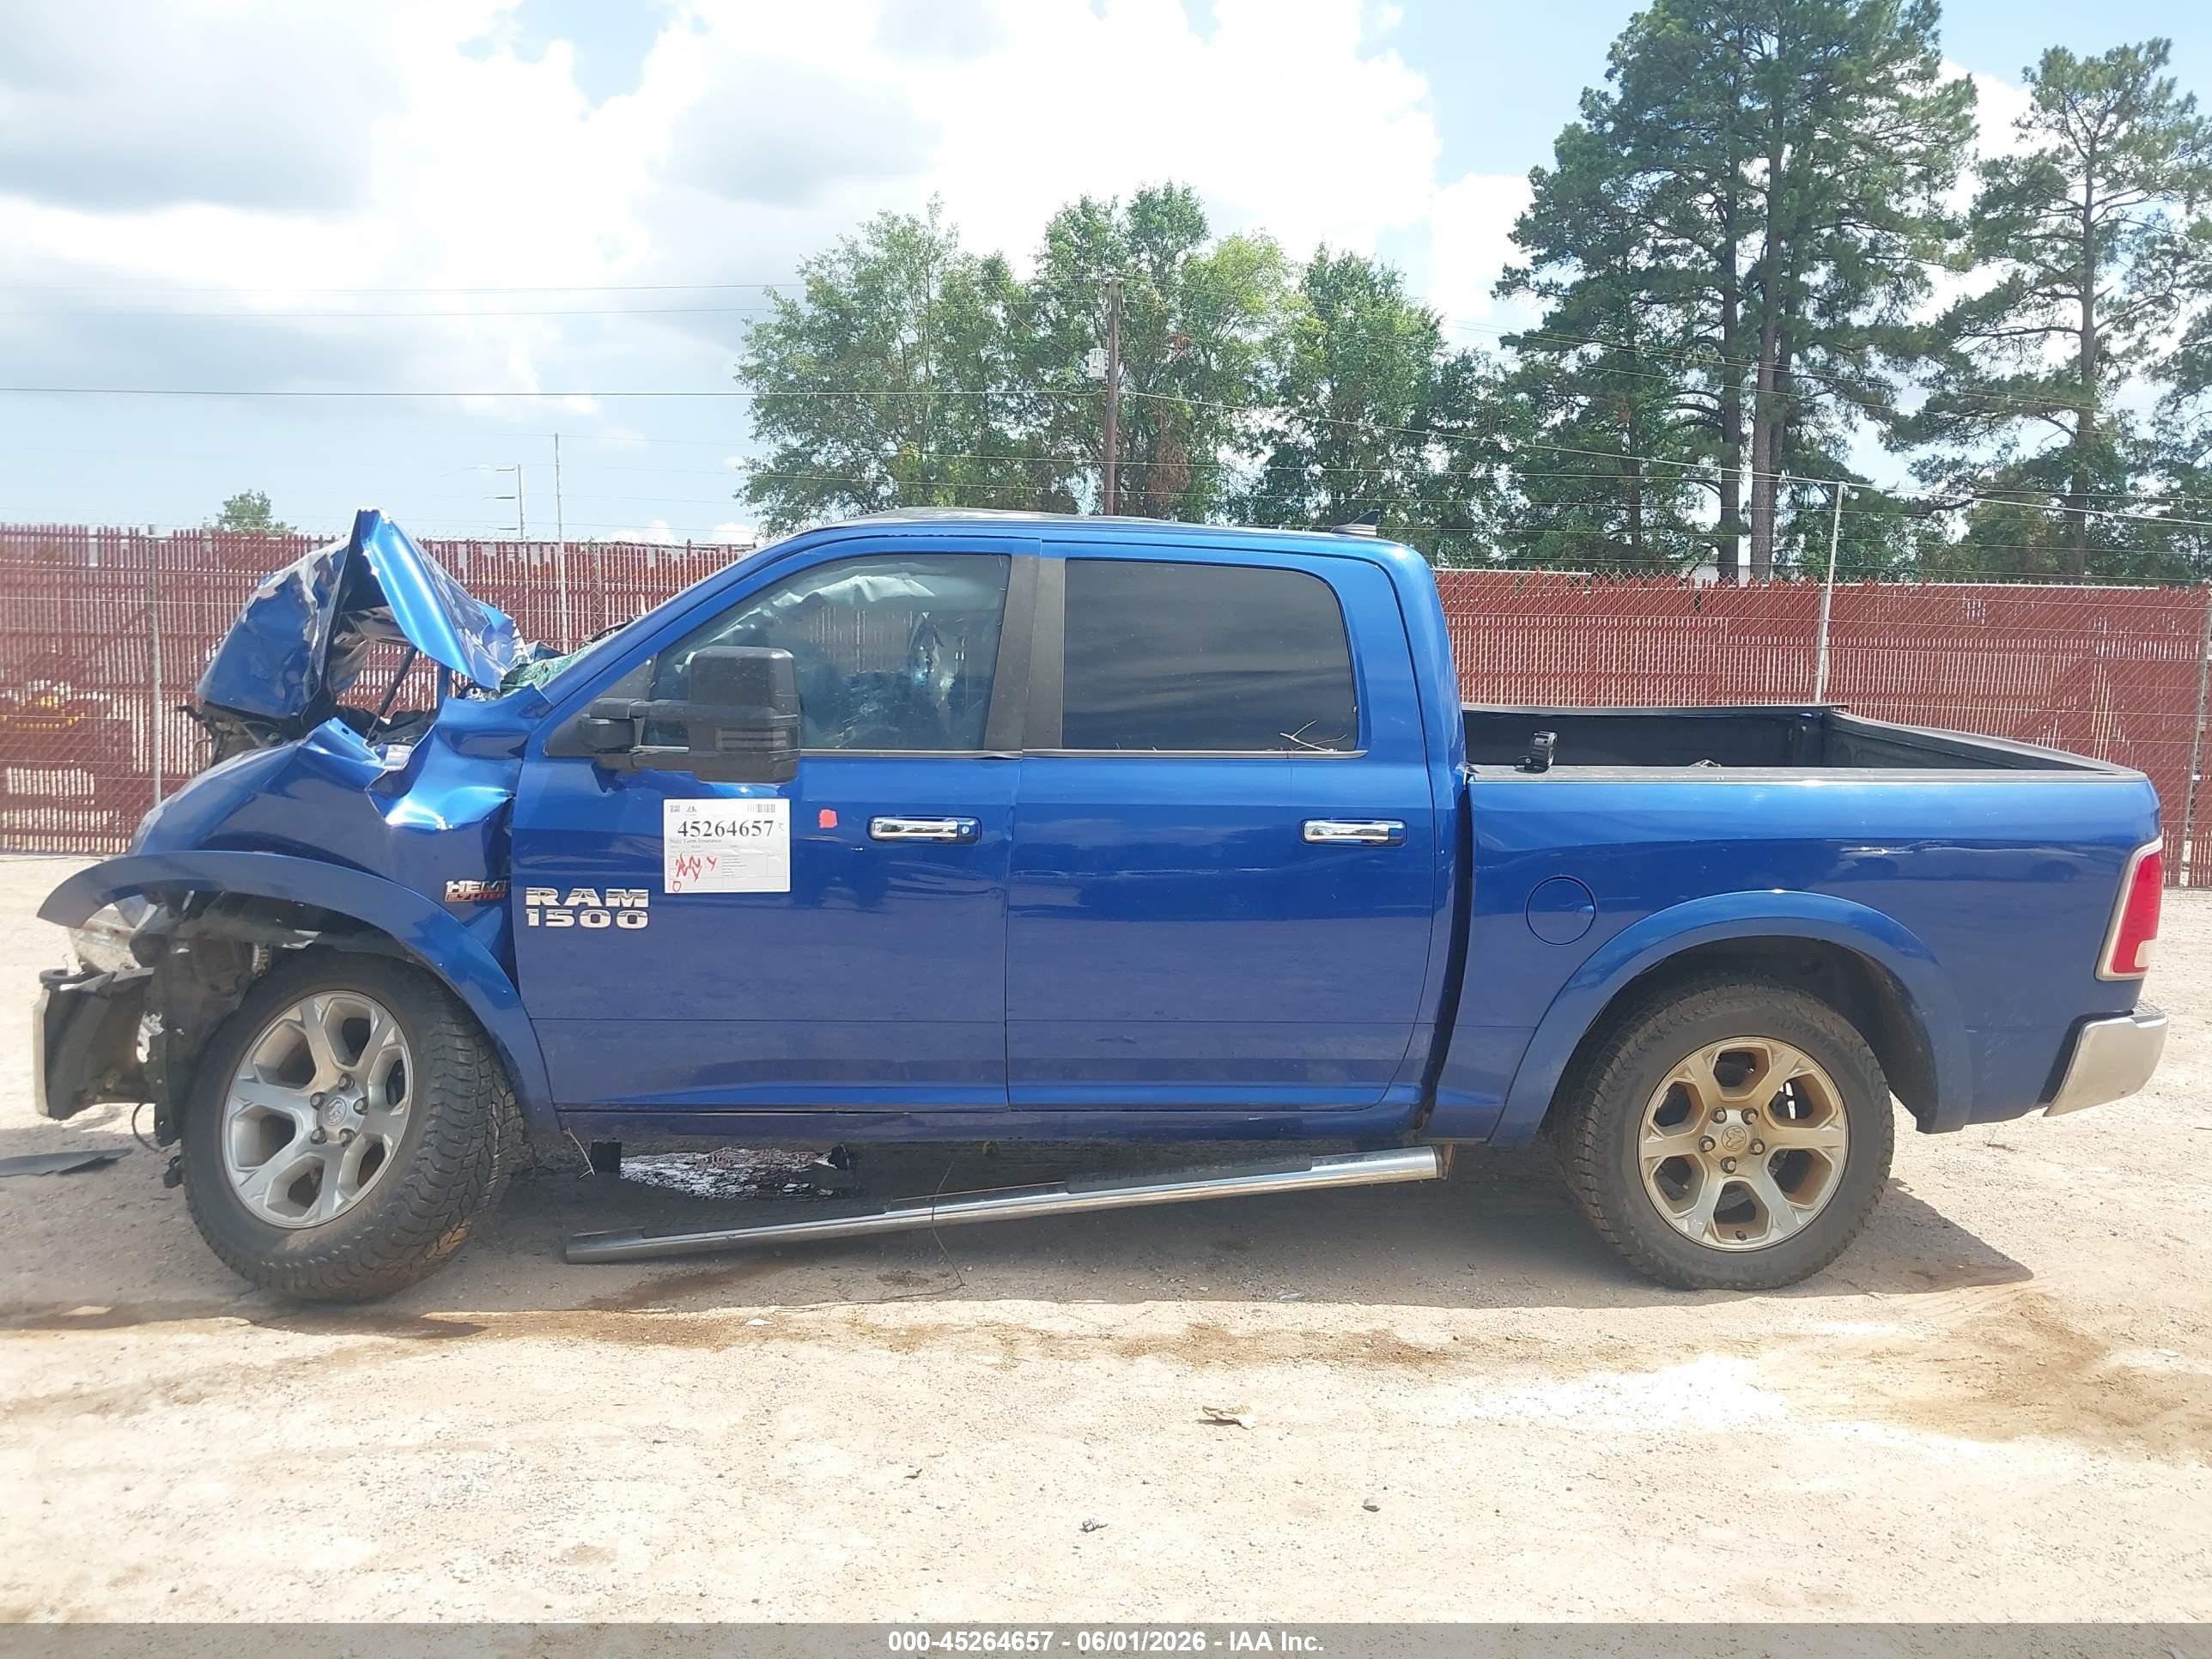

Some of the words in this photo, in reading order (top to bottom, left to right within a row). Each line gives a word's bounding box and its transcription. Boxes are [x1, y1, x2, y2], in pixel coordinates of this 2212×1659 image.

[677, 820, 775, 837] 45264657
[446, 880, 507, 893] HEMI
[526, 887, 649, 907] RAM
[526, 908, 648, 929] 1500
